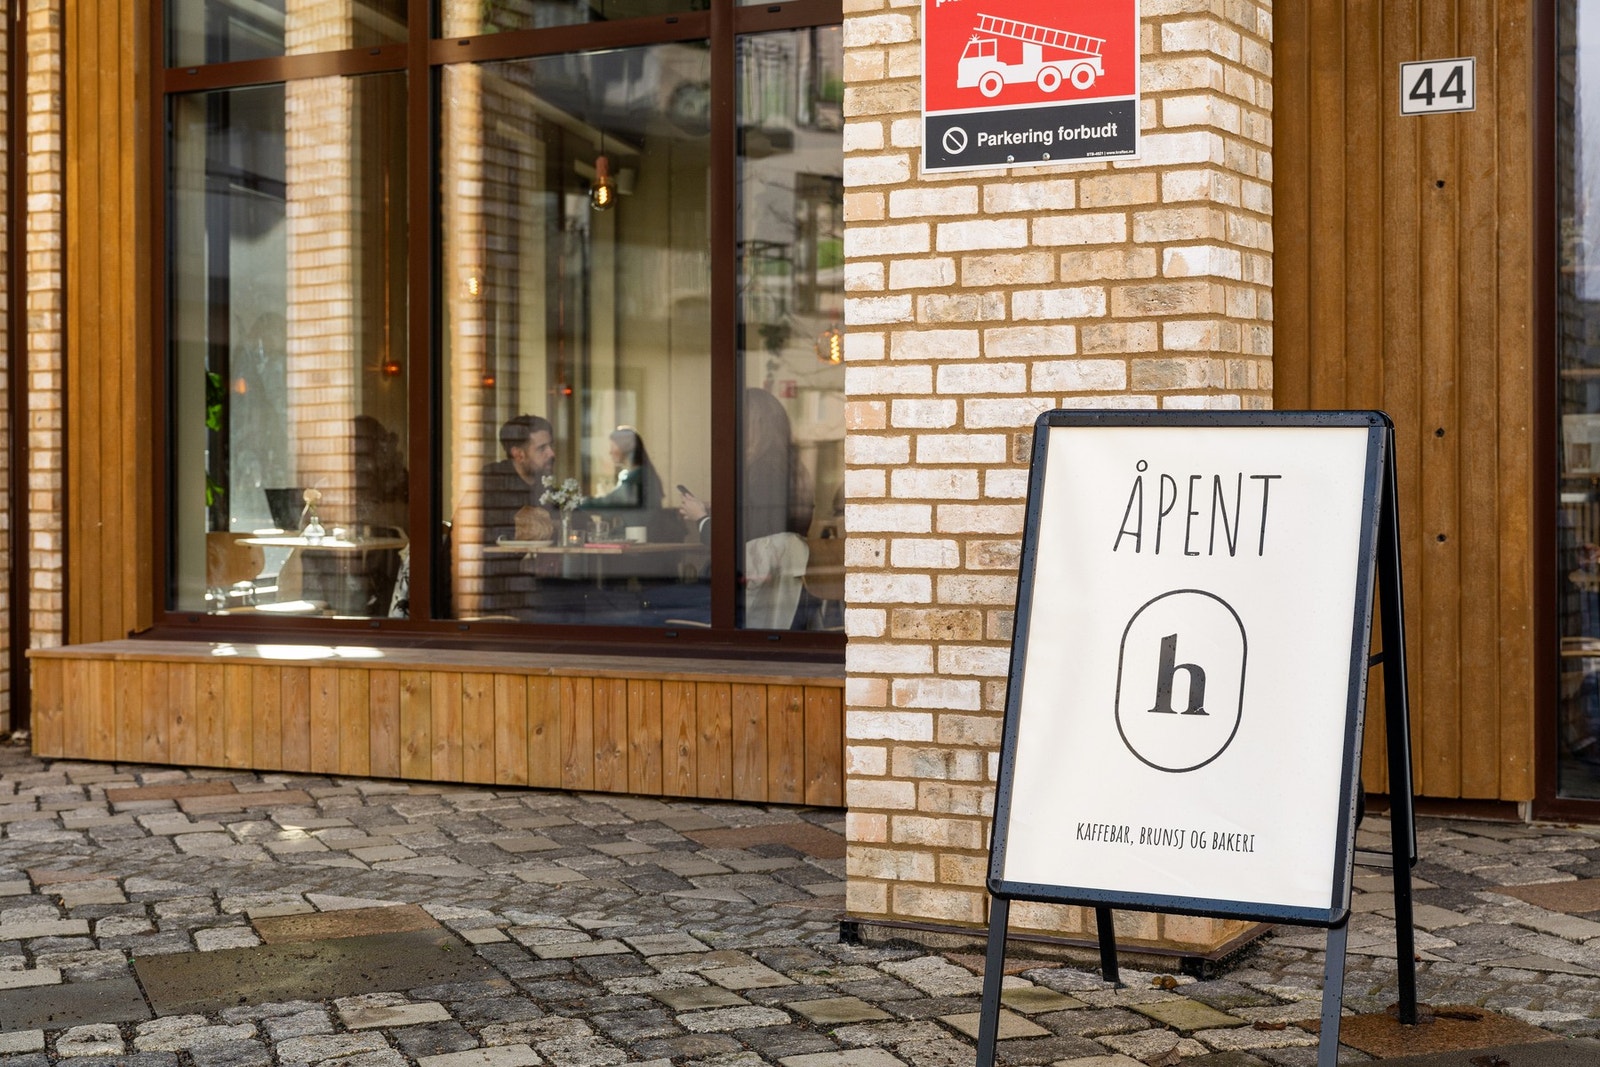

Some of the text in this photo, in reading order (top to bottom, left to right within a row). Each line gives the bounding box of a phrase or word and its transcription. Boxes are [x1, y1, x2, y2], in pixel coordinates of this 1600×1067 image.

[1409, 65, 1466, 106] 44
[977, 122, 1118, 146] Parkering forbudt
[1112, 459, 1282, 558] ÅPENT
[1147, 633, 1210, 716] h
[1076, 822, 1256, 853] KAFFEBAR, BRUNSJ OG BAKERI
